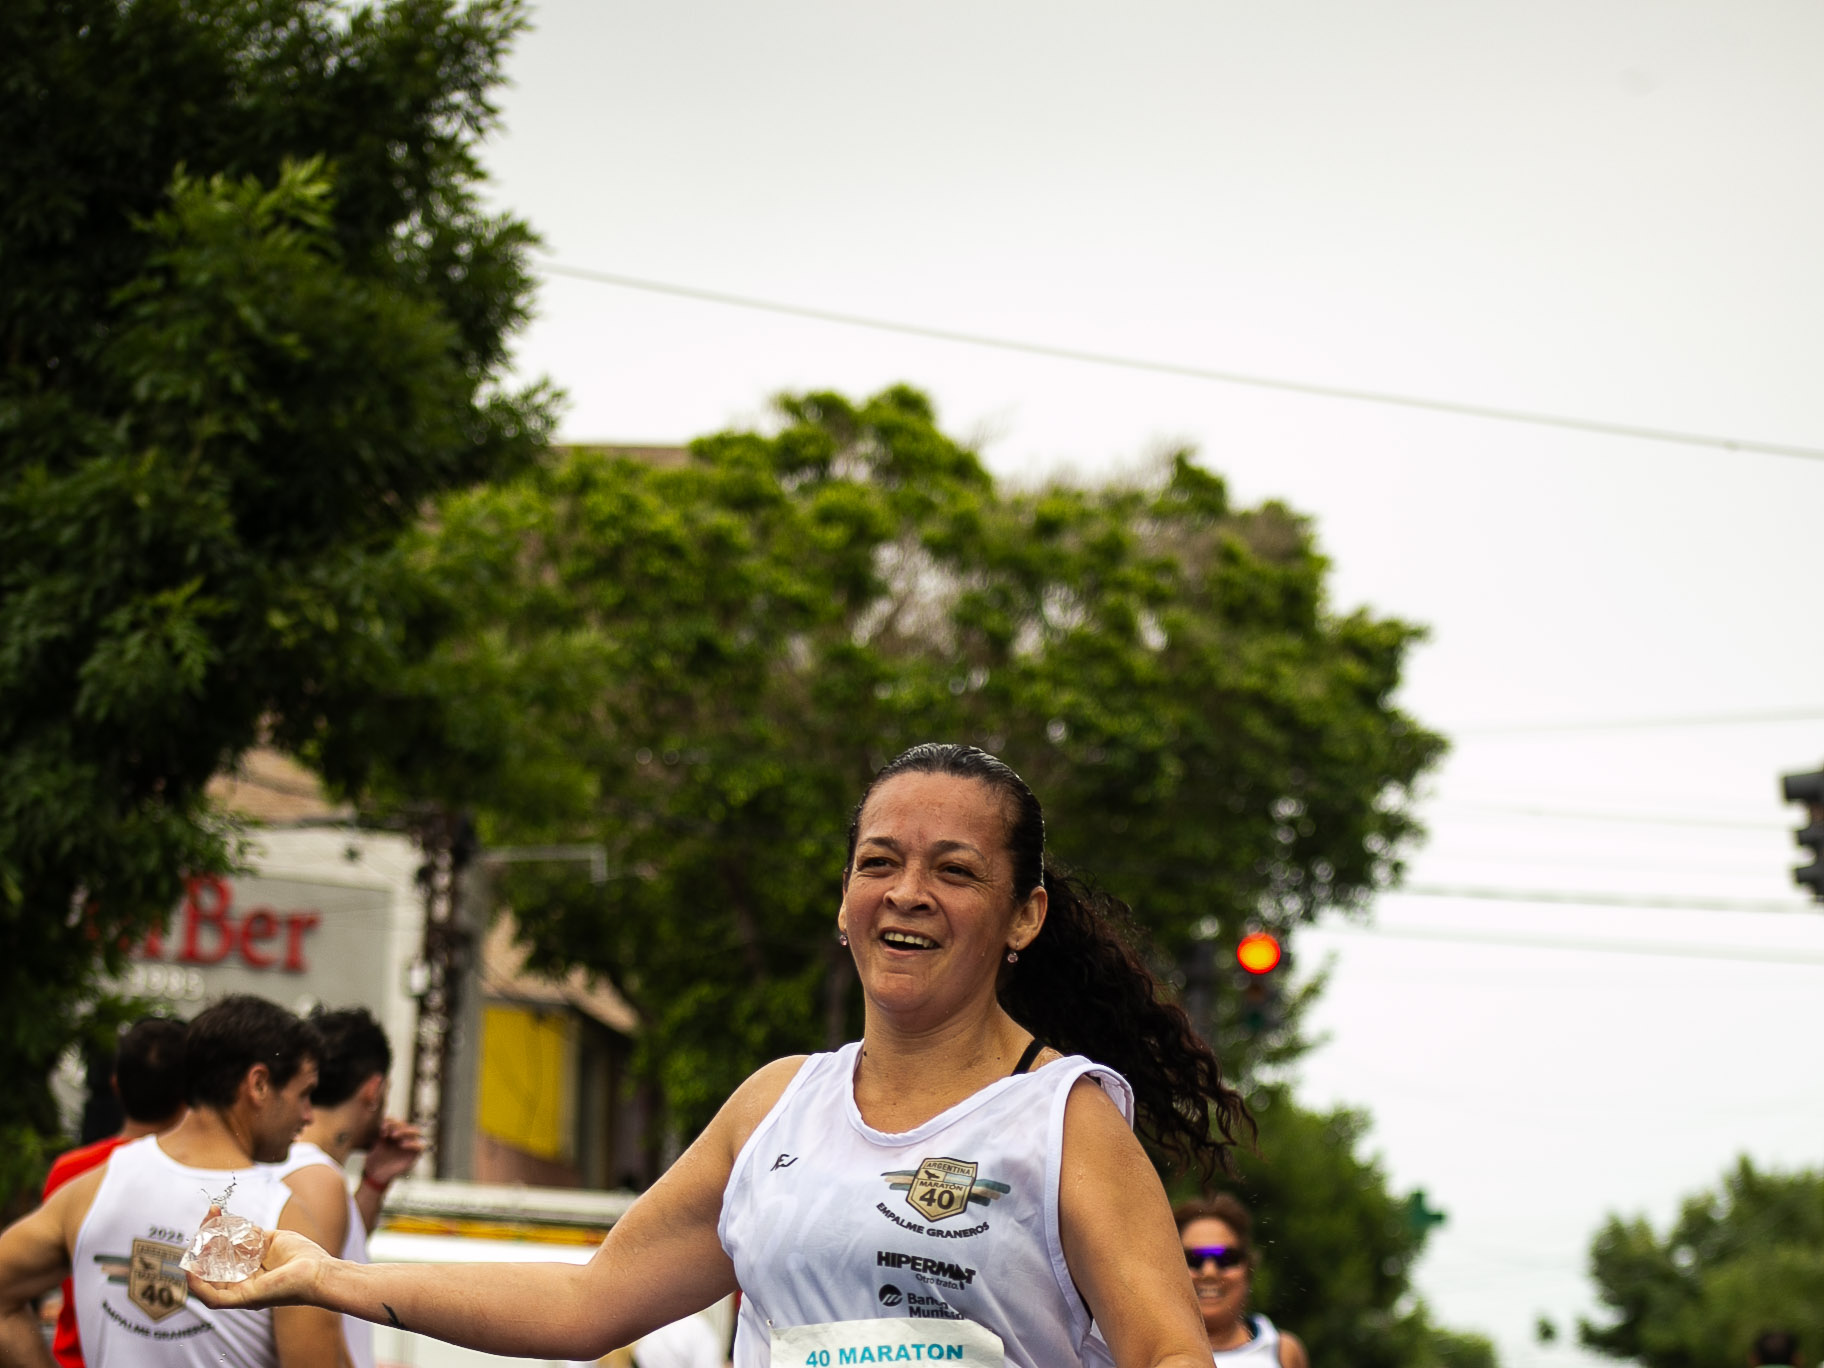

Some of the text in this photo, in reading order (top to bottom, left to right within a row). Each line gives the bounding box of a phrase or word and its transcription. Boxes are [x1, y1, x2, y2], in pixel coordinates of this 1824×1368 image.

[926, 1160, 971, 1176] ARGENTINA
[919, 1189, 955, 1210] 40
[876, 1202, 990, 1239] EMPALME GRANEROS
[915, 1273, 935, 1285] Otro
[141, 1284, 174, 1307] 40
[806, 1343, 964, 1368] 40 MARATON
